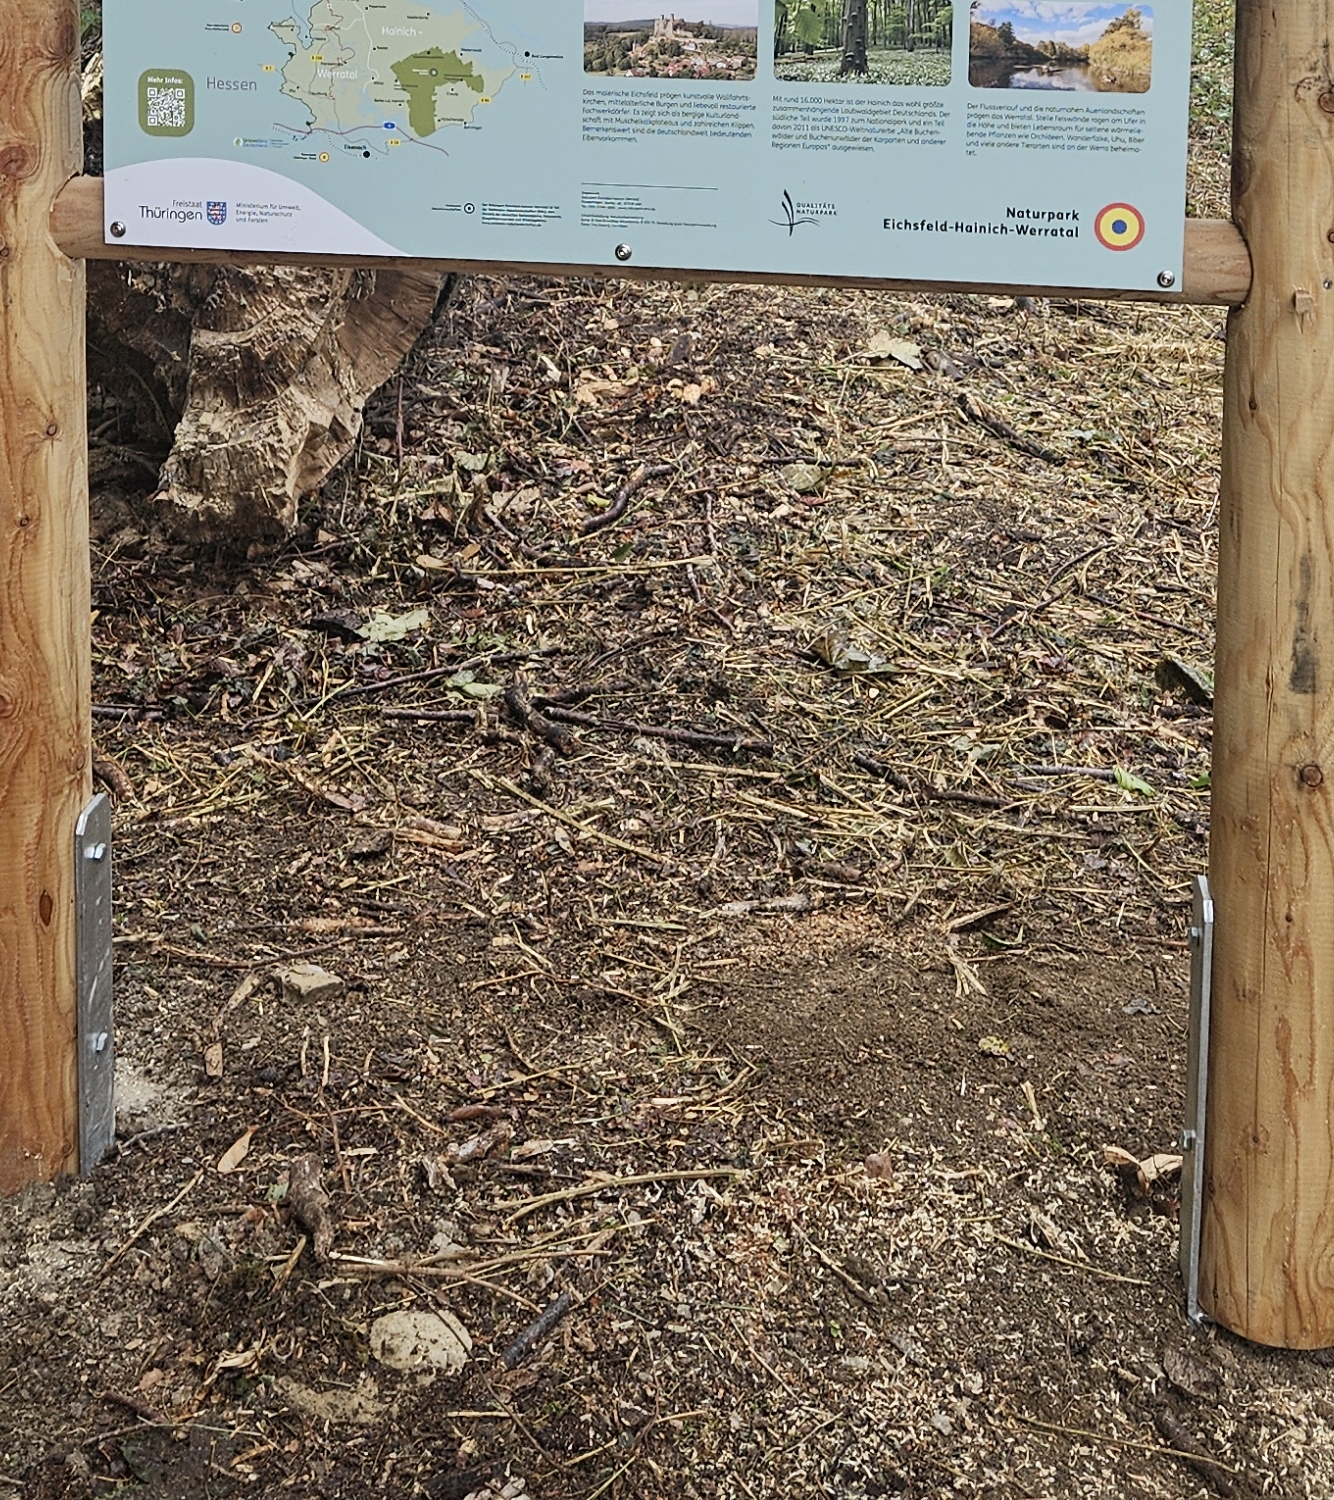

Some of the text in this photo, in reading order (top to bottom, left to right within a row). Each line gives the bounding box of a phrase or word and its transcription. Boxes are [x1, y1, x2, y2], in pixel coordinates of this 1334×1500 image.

[381, 26, 416, 36] Hainich
[316, 68, 358, 79] Werratal
[207, 76, 257, 91] Hessen
[172, 199, 202, 208] Freistaat
[138, 206, 203, 223] Thüringen
[1006, 207, 1079, 221] Naturpark
[883, 218, 1078, 238] Eichsfeld-Hainich-Werratal
